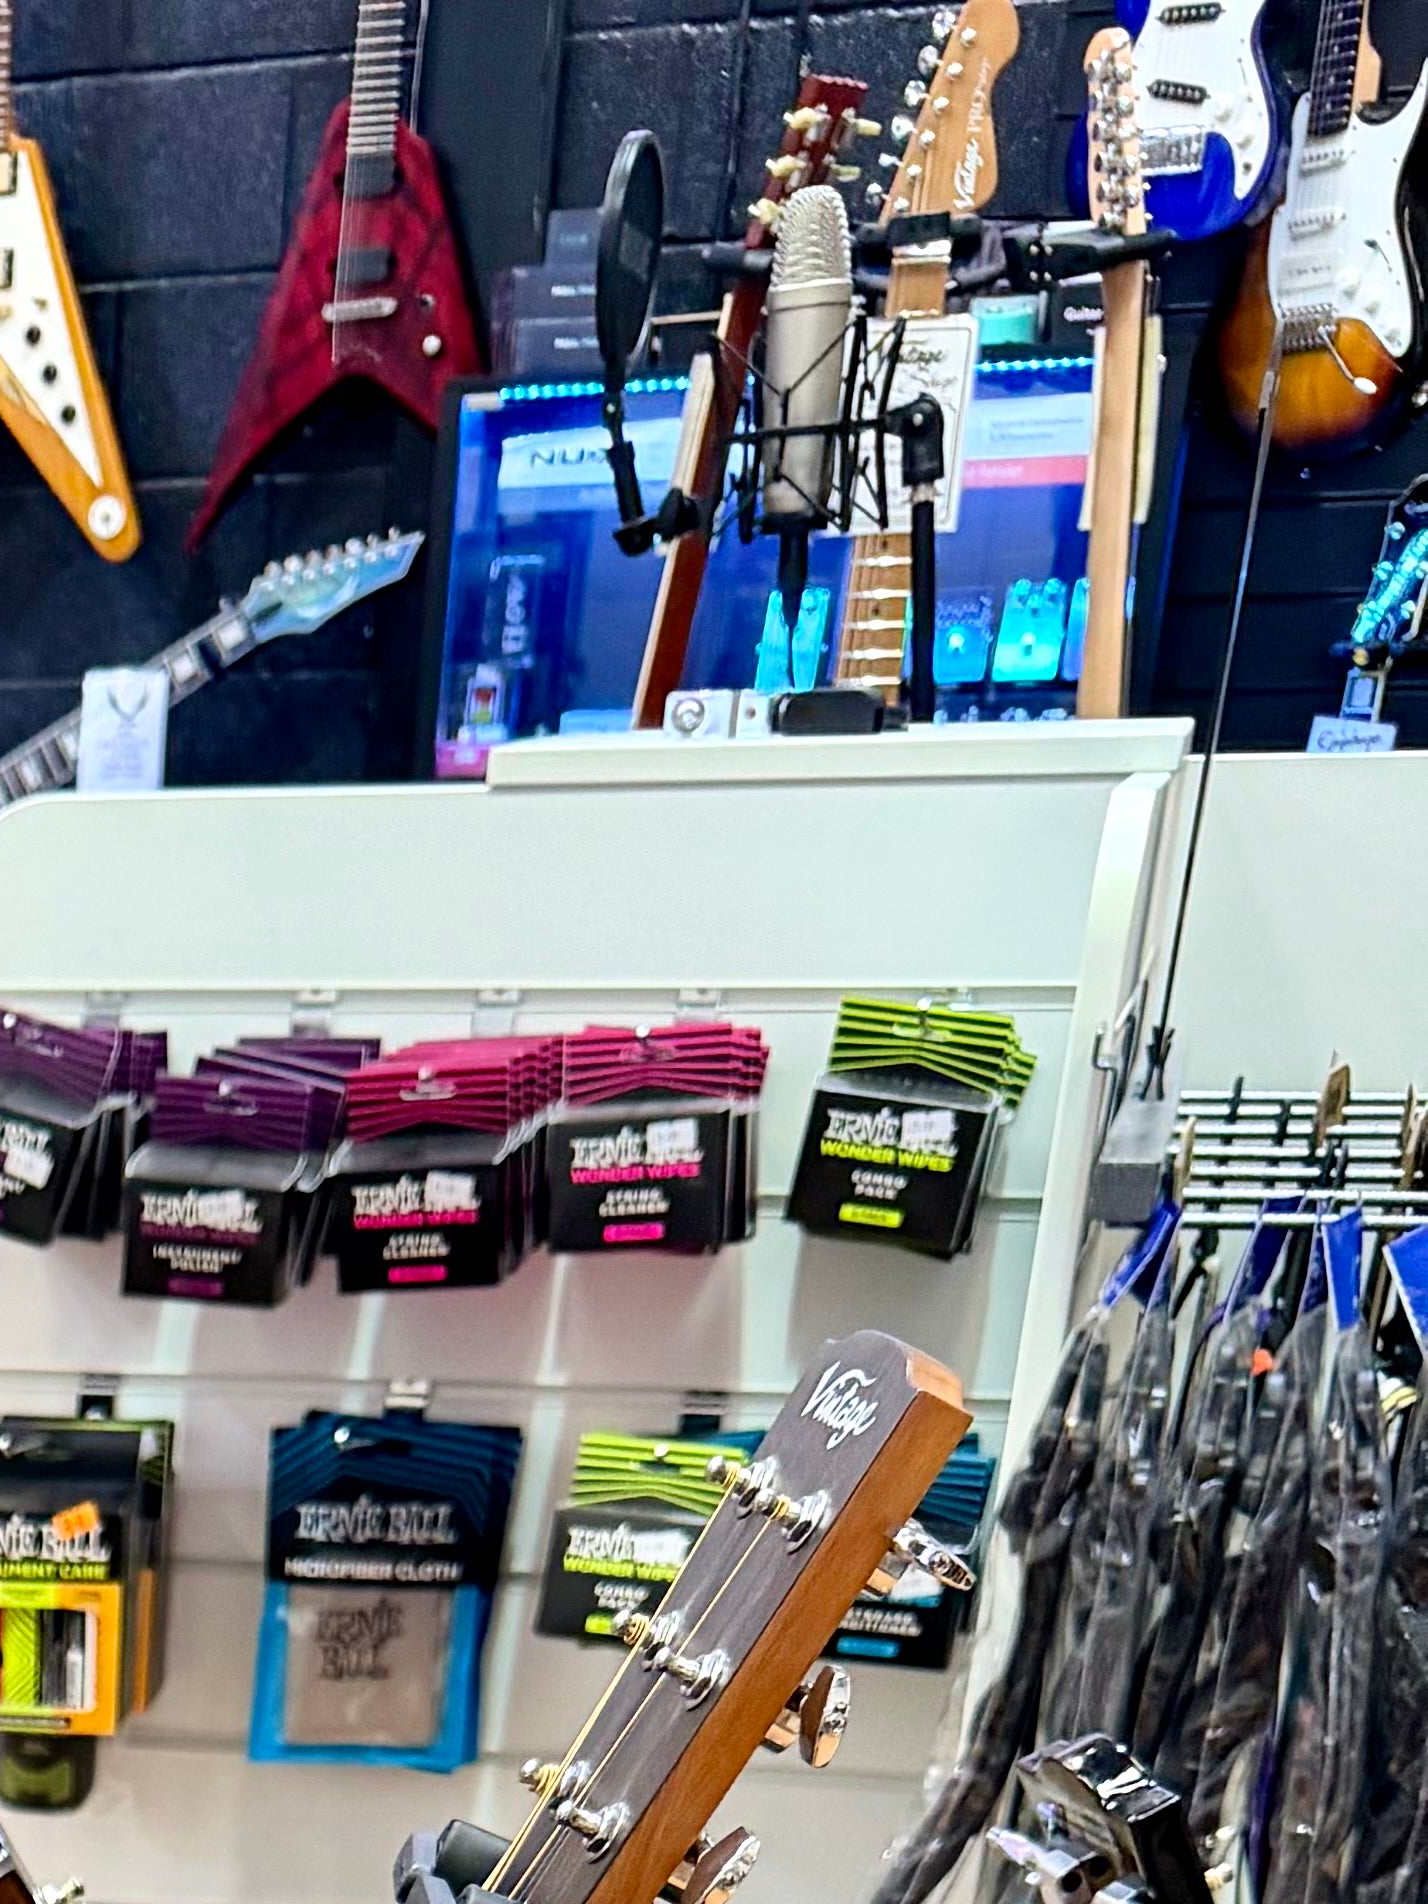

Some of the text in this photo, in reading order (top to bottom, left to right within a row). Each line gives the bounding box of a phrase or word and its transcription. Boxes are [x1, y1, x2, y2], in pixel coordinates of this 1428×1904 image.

[820, 1138, 955, 1172] WONDER WIPES
[570, 1162, 701, 1184] WONDER WIPES
[800, 1360, 879, 1450] Vintage
[297, 1493, 459, 1545] ERNIE BALL
[59, 1560, 110, 1580] CARE
[395, 1559, 463, 1581] CLOTH
